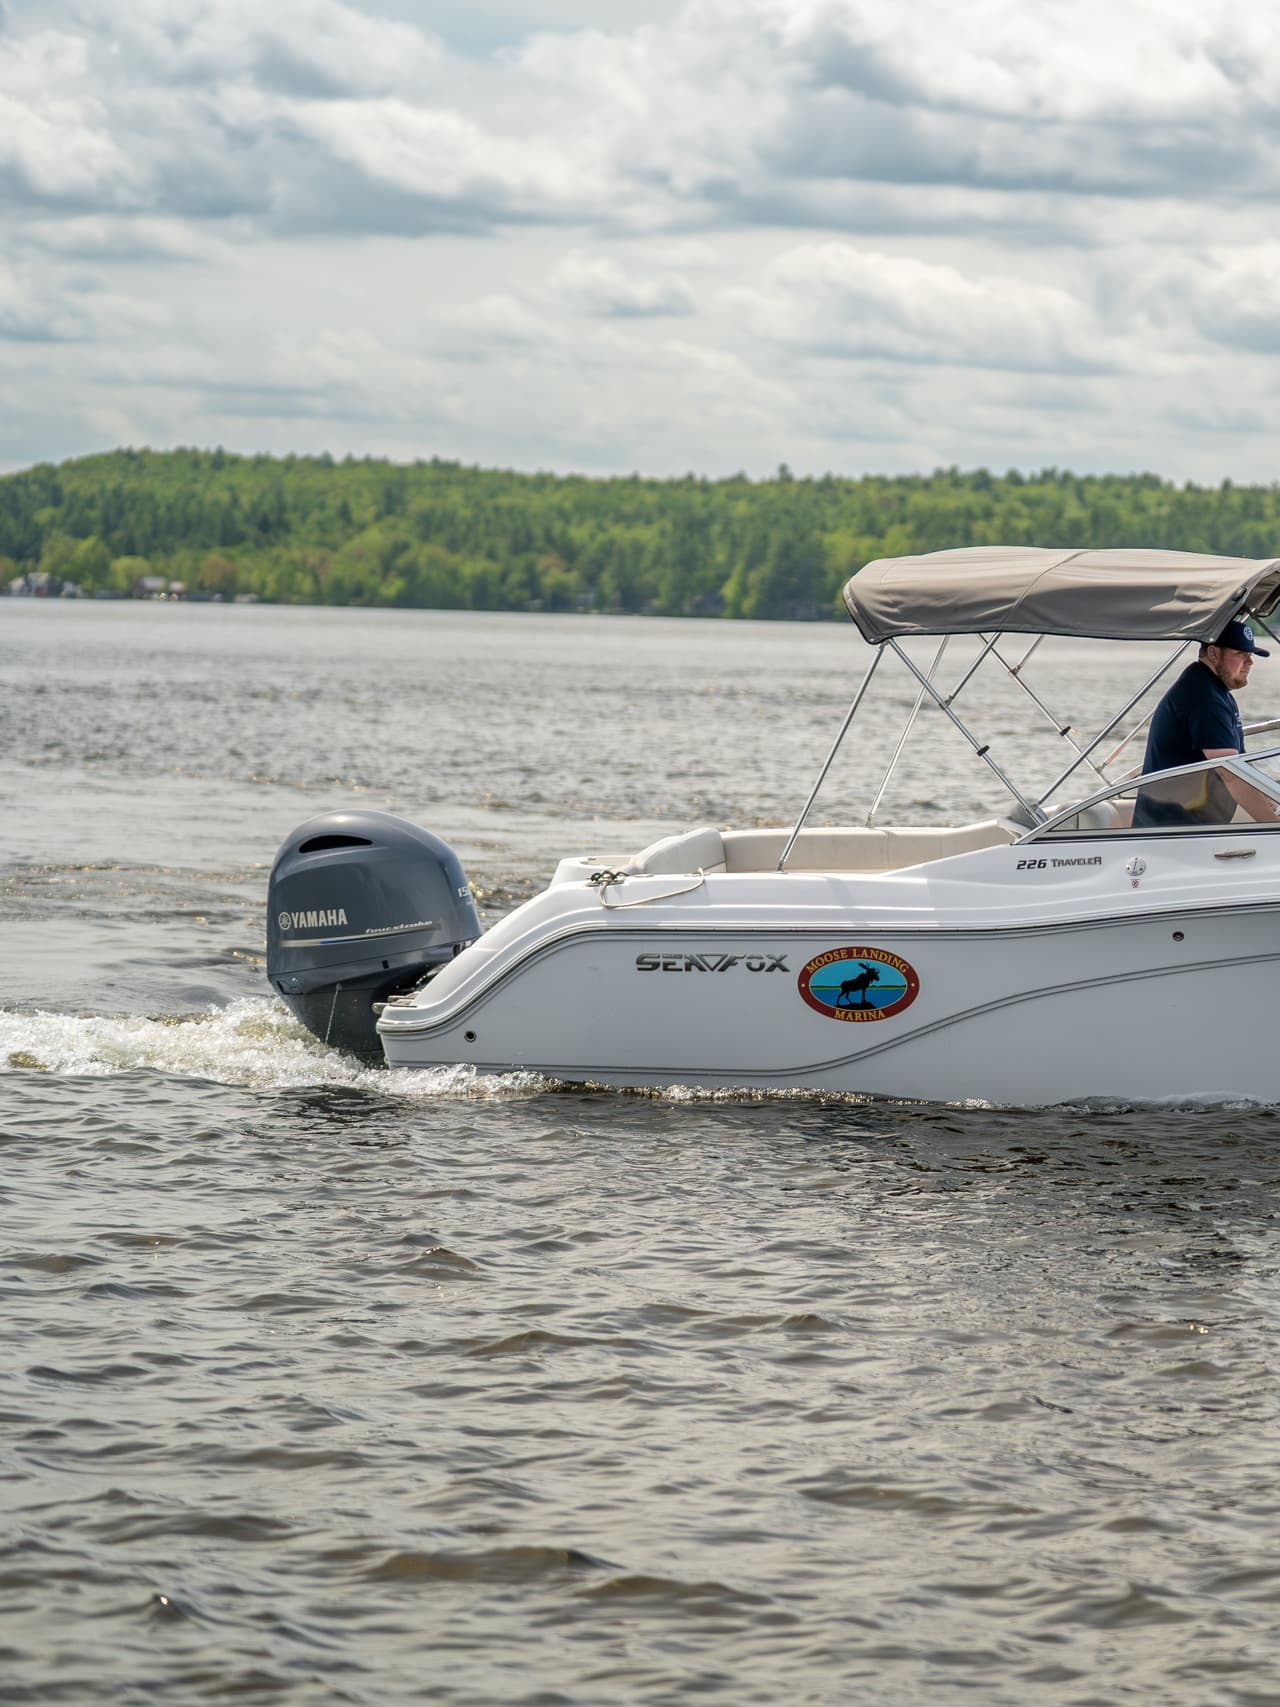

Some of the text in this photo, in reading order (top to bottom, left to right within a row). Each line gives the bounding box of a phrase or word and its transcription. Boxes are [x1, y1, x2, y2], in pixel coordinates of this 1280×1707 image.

[1016, 859, 1047, 870] 226
[291, 908, 348, 929] YAMAHA
[806, 948, 909, 974] MOOSE LANDING
[834, 1009, 886, 1022] MARINA
